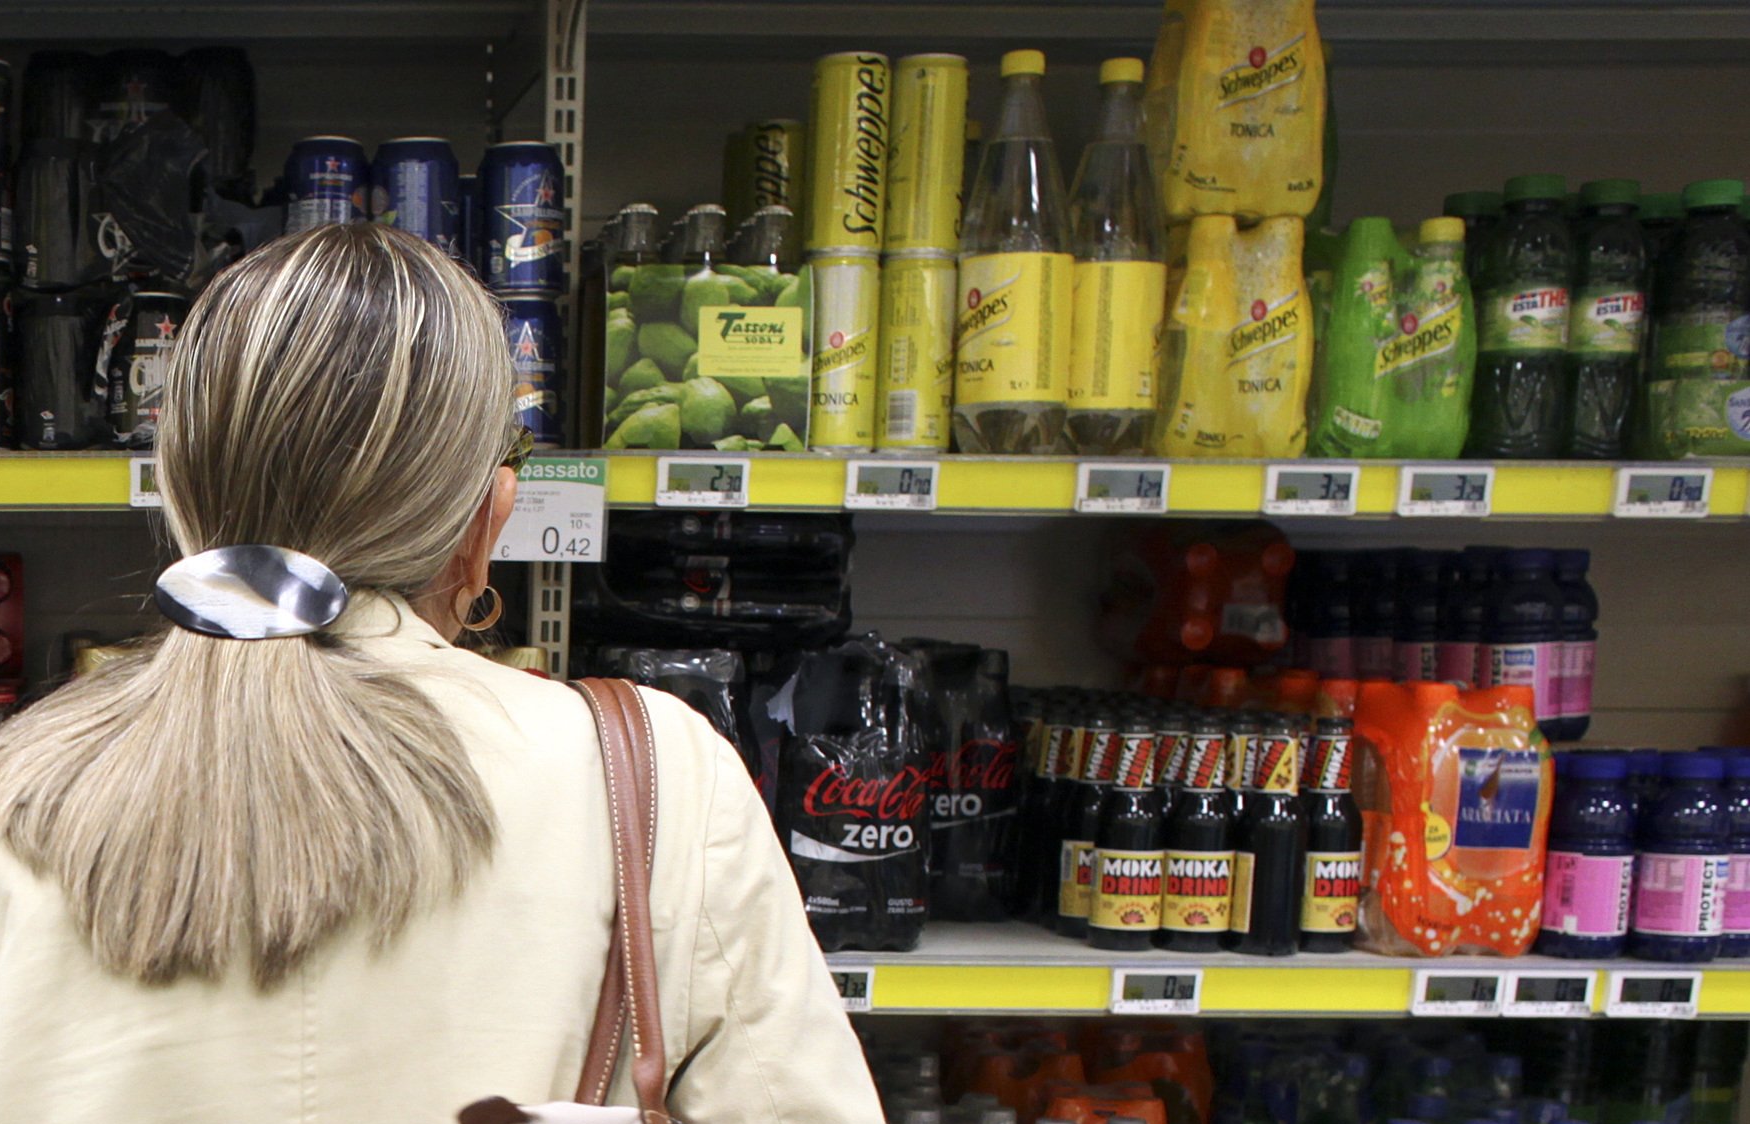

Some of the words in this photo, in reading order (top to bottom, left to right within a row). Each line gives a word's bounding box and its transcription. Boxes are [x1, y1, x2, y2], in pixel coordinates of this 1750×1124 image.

[1218, 50, 1300, 99] Schweppes
[1229, 120, 1275, 139] TONICA
[842, 53, 888, 246] Schweppes
[1228, 304, 1300, 356] Schweppes
[1237, 377, 1283, 394] TONICA
[516, 461, 598, 479] bassato
[543, 526, 591, 558] 0,42
[842, 823, 914, 850] zero
[1103, 858, 1162, 878] MOKA
[1167, 858, 1230, 878] MOKA
[1617, 859, 1632, 933] PROTECT
[1698, 859, 1715, 933] PROTECT
